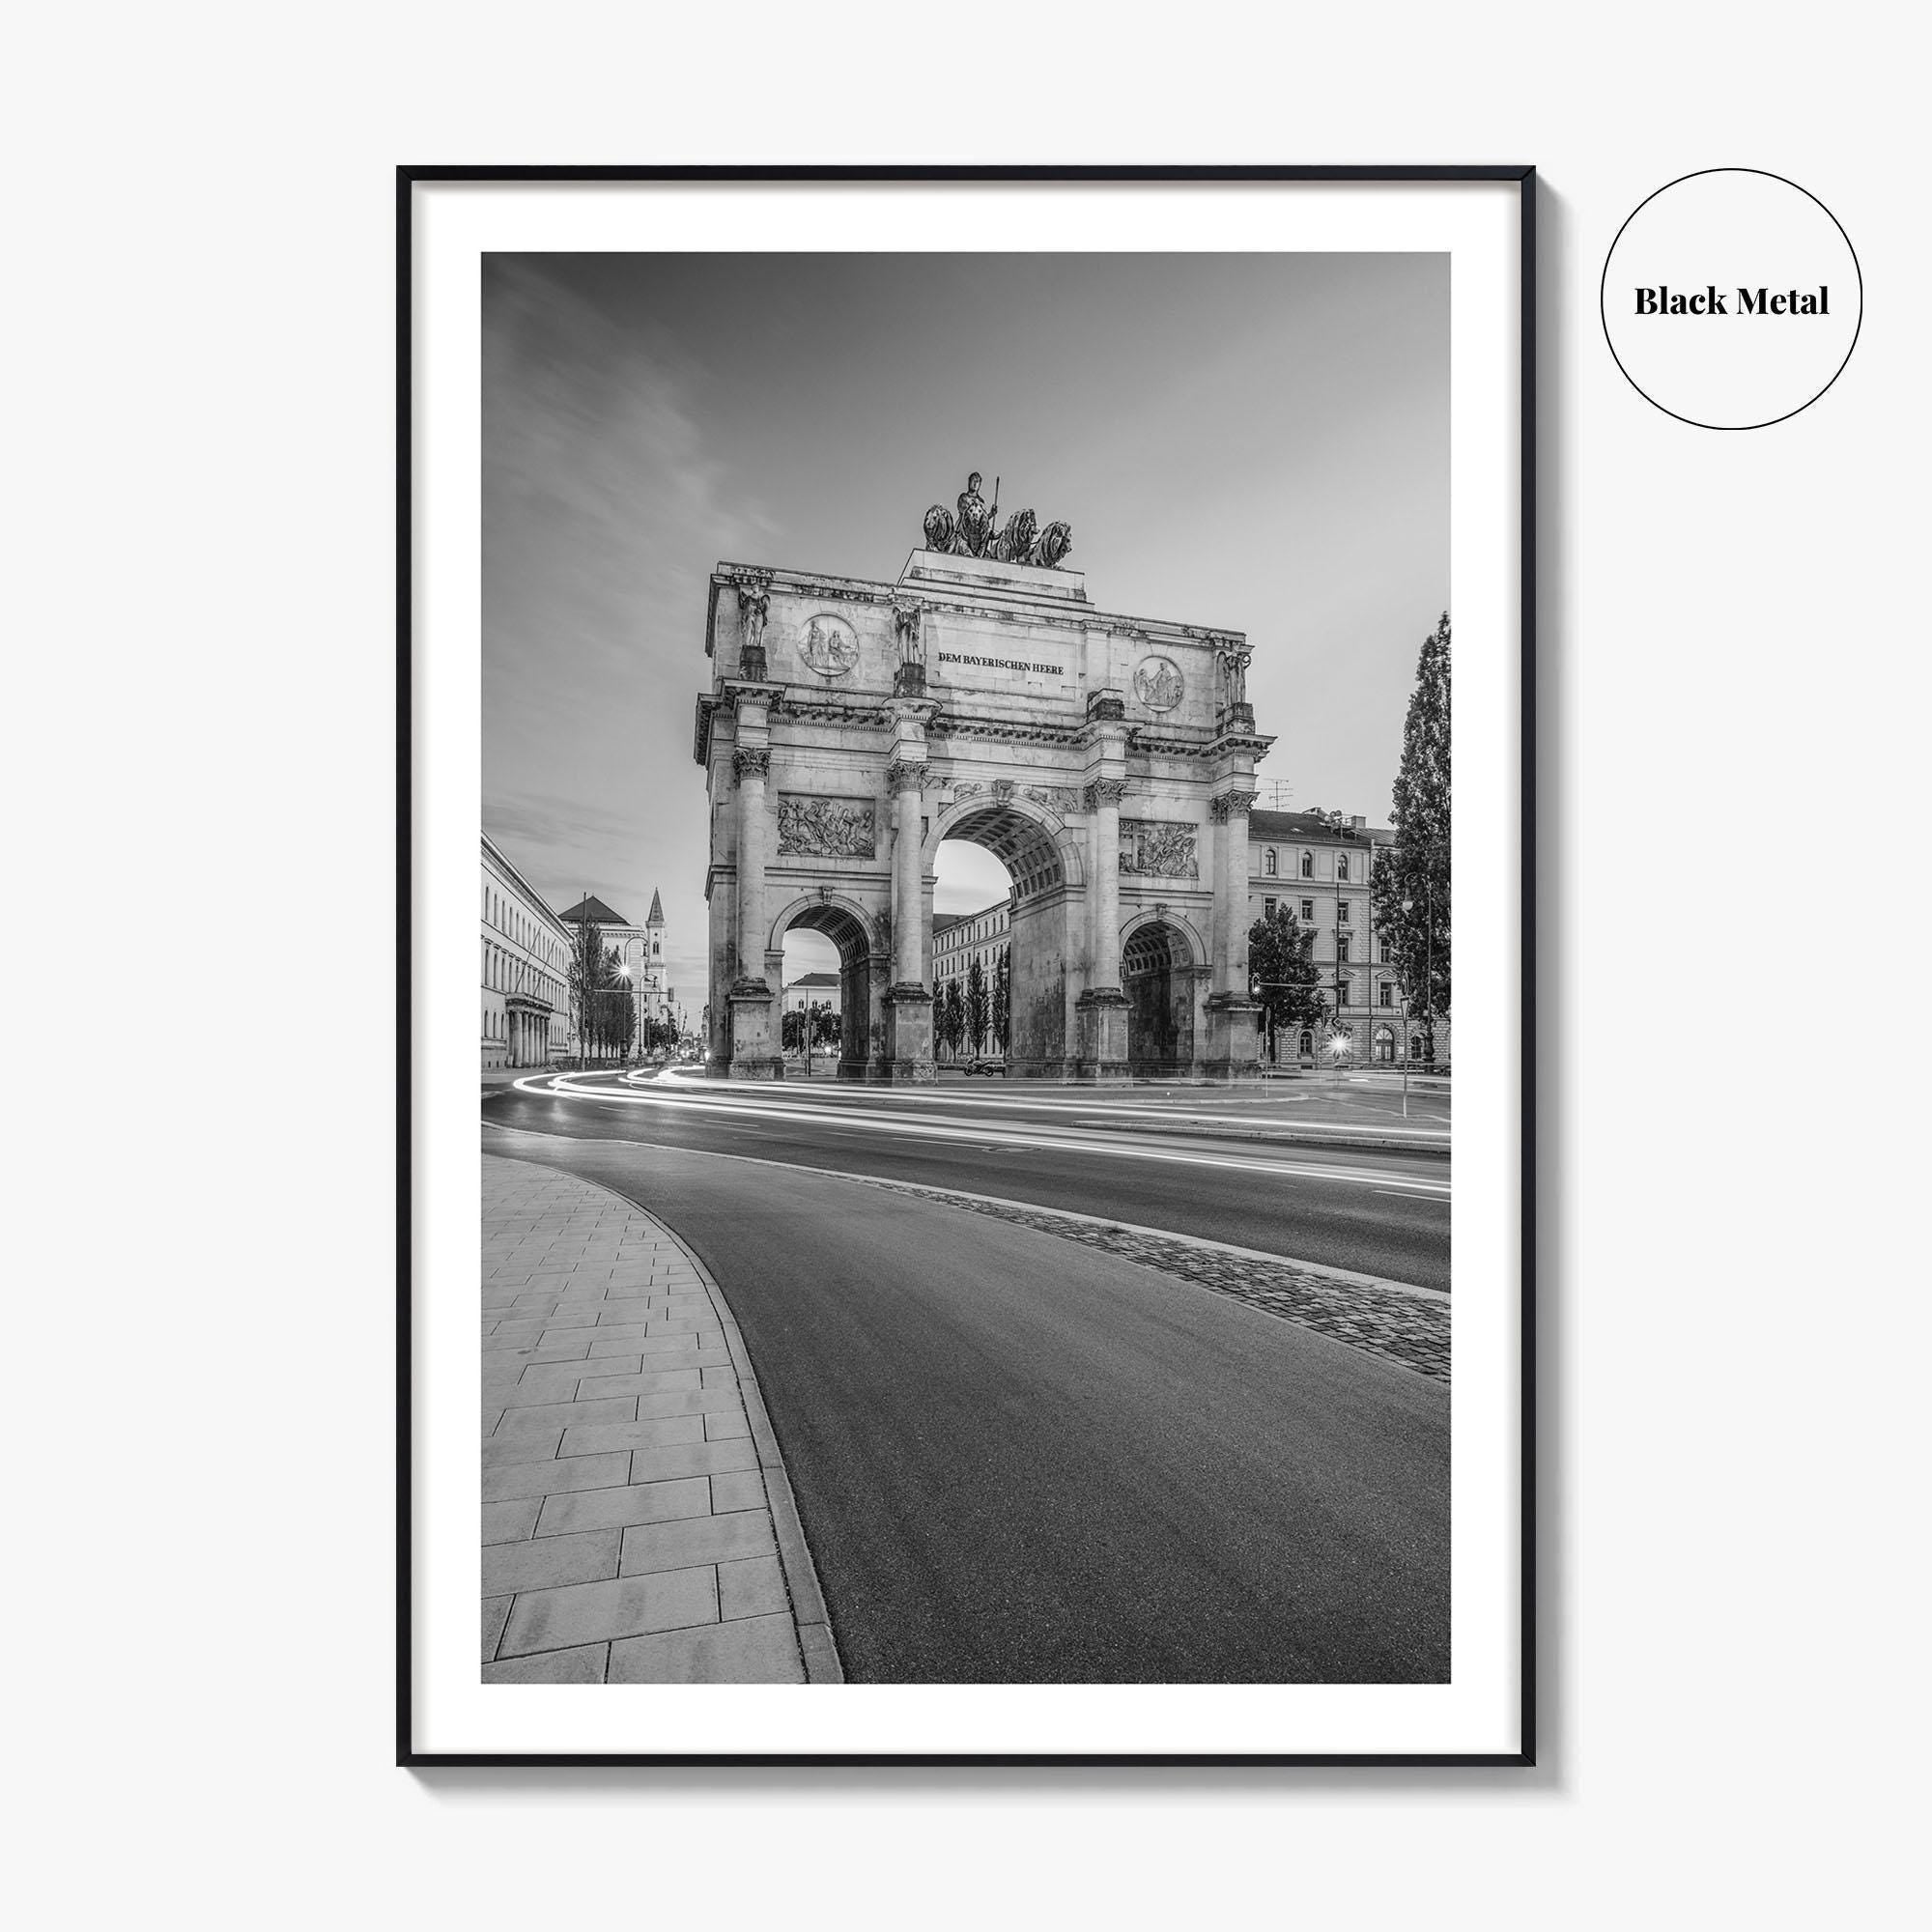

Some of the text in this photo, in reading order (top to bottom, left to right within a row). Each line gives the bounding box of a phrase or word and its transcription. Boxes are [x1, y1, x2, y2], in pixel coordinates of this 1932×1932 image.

[938, 652, 1064, 675] DEM BAYERISCHEN HEERE
